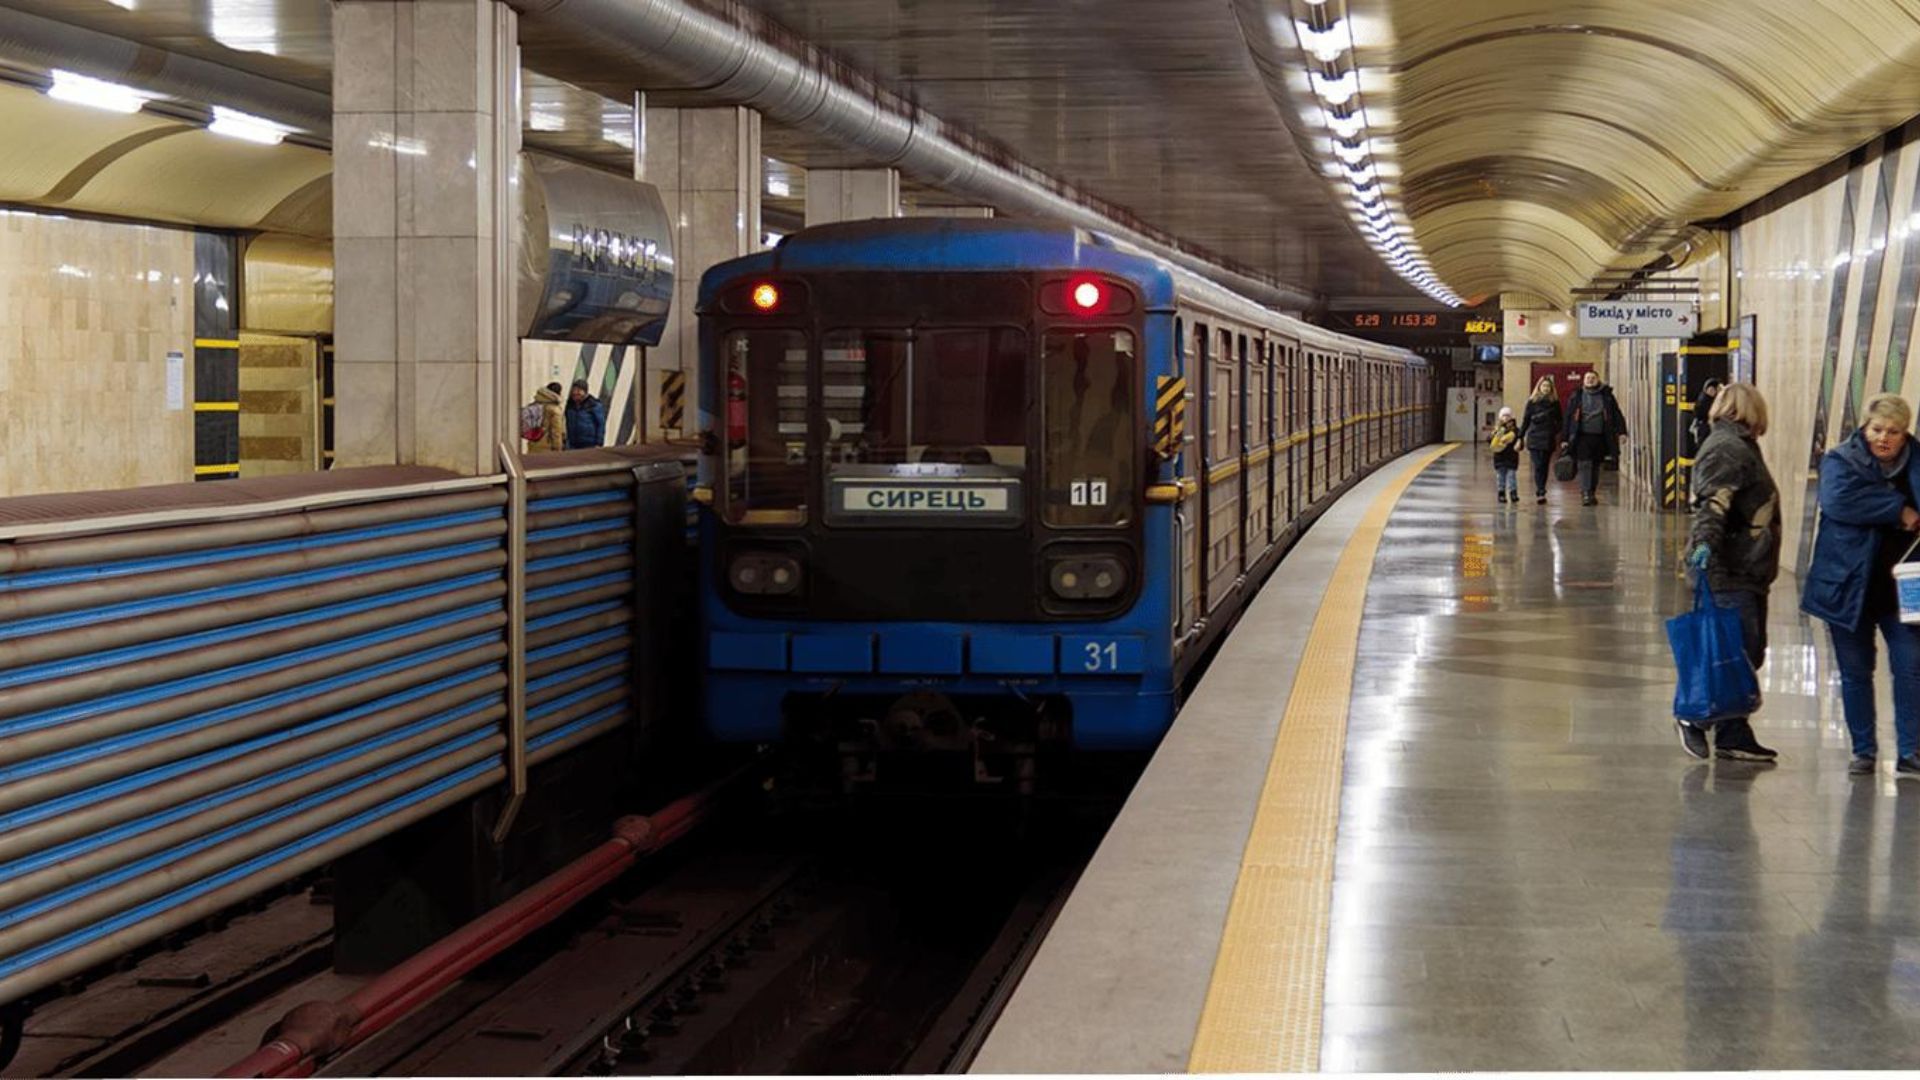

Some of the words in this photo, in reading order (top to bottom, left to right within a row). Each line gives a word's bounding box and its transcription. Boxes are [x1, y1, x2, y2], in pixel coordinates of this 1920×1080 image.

[1588, 305, 1624, 320] Вихід
[1626, 308, 1633, 320] у
[1636, 305, 1673, 318] місто
[1617, 324, 1639, 335] Exit
[866, 489, 986, 511] СИРЕЦЬ
[1085, 642, 1117, 671] 31
